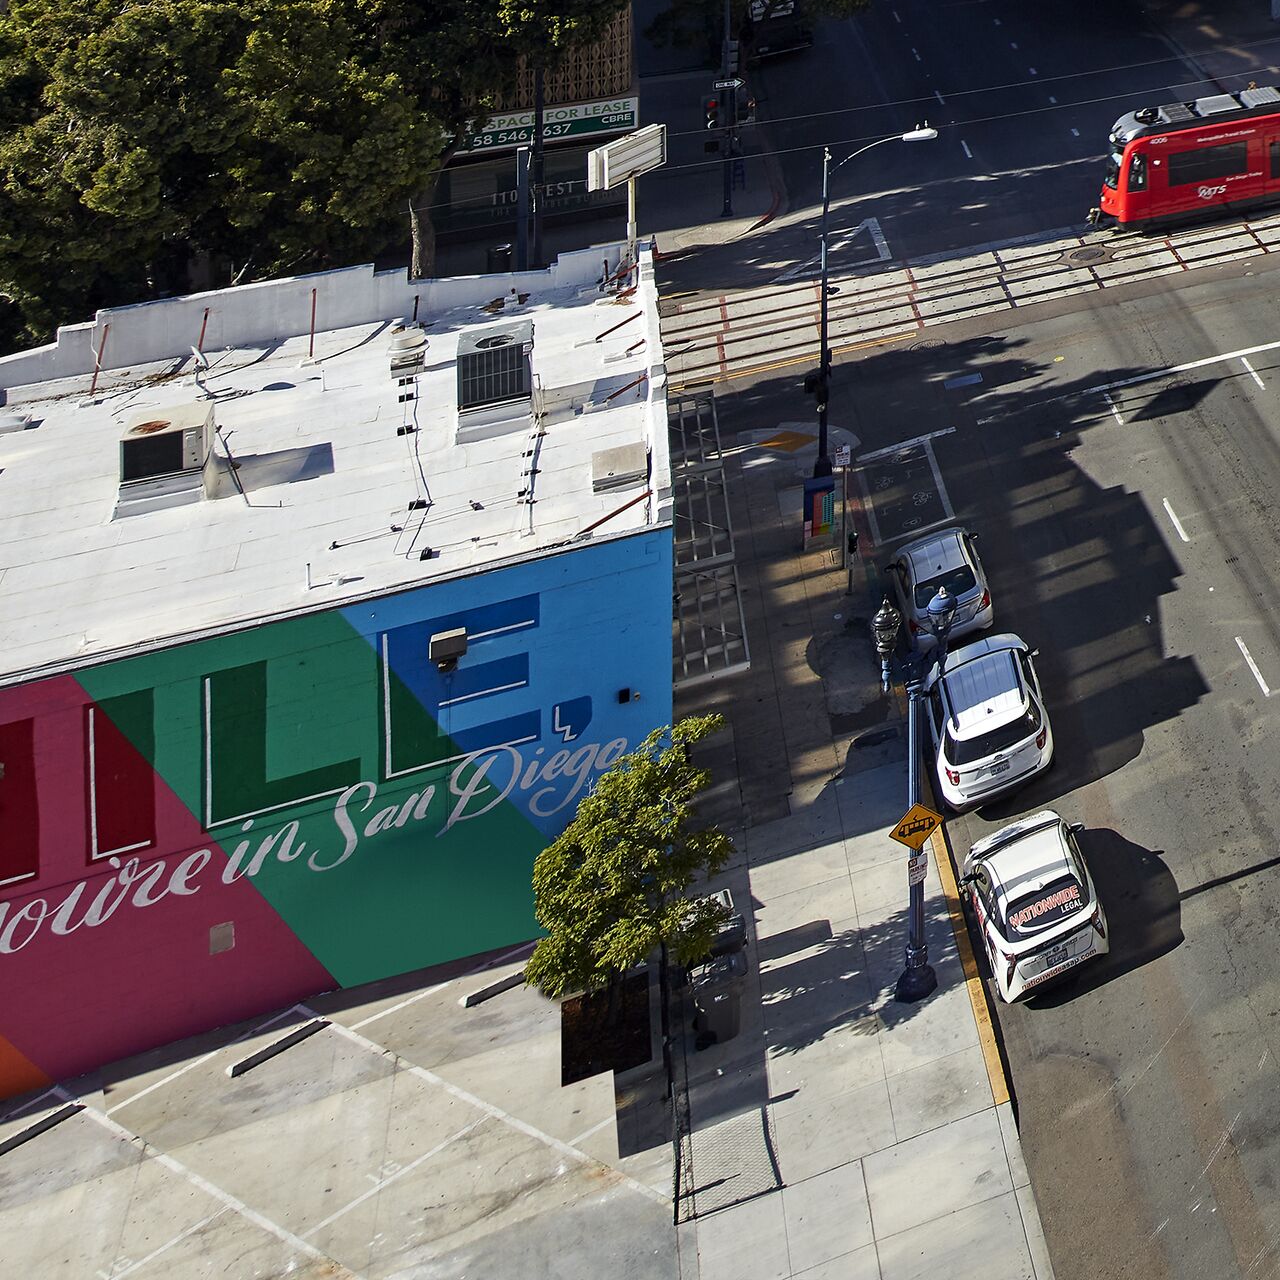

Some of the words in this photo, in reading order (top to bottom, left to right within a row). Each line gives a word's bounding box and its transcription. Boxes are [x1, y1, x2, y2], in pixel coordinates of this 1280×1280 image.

[545, 109, 578, 122] FOR
[584, 101, 631, 115] LEASE
[601, 113, 632, 124] CBRE
[498, 131, 528, 143] 546
[532, 123, 572, 137] 637
[1198, 185, 1228, 198] MTS
[0, 592, 592, 890] ILE,
[221, 819, 306, 884] in
[307, 781, 436, 872] San
[435, 737, 628, 838] Diego
[1009, 884, 1080, 928] NATIONWIDE
[1060, 899, 1083, 914] LEGAL
[1021, 948, 1097, 991] nationwideasap.com
